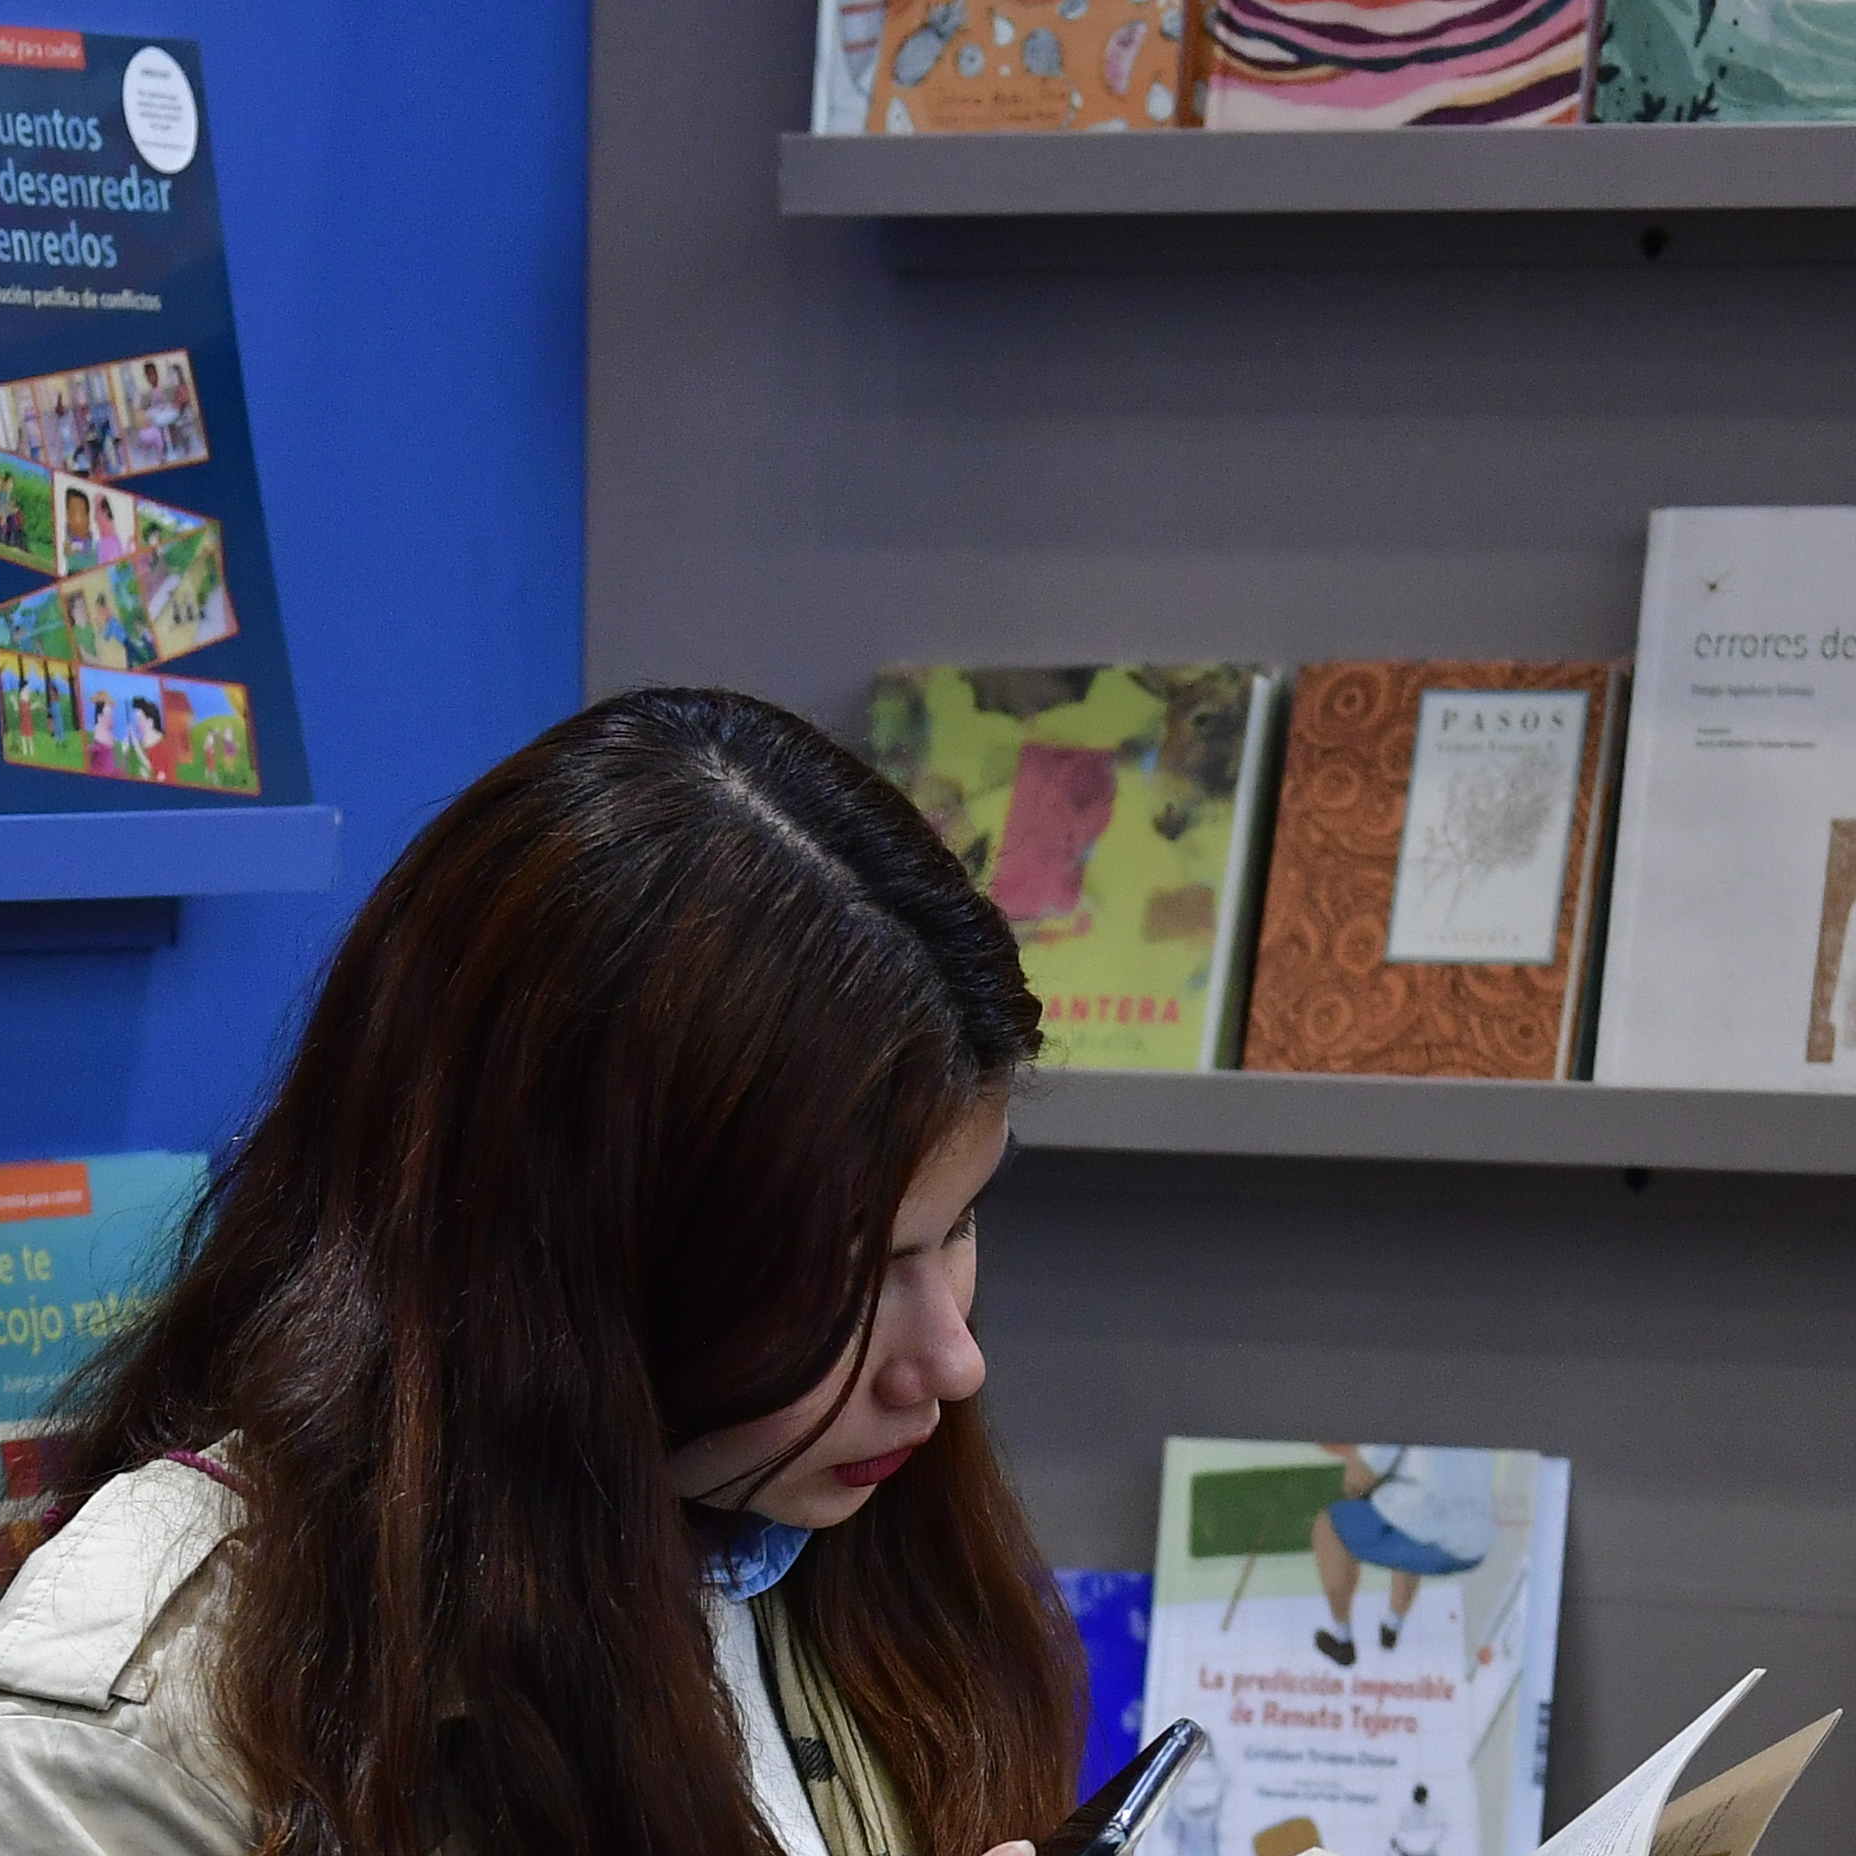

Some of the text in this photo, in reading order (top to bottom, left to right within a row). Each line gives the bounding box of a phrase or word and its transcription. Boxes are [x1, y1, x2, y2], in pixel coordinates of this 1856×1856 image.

[1693, 631, 1809, 660] errores
[1441, 709, 1567, 733] PASOS
[22, 1243, 52, 1282] te
[1198, 1664, 1225, 1690] La
[1229, 1701, 1257, 1726] de
